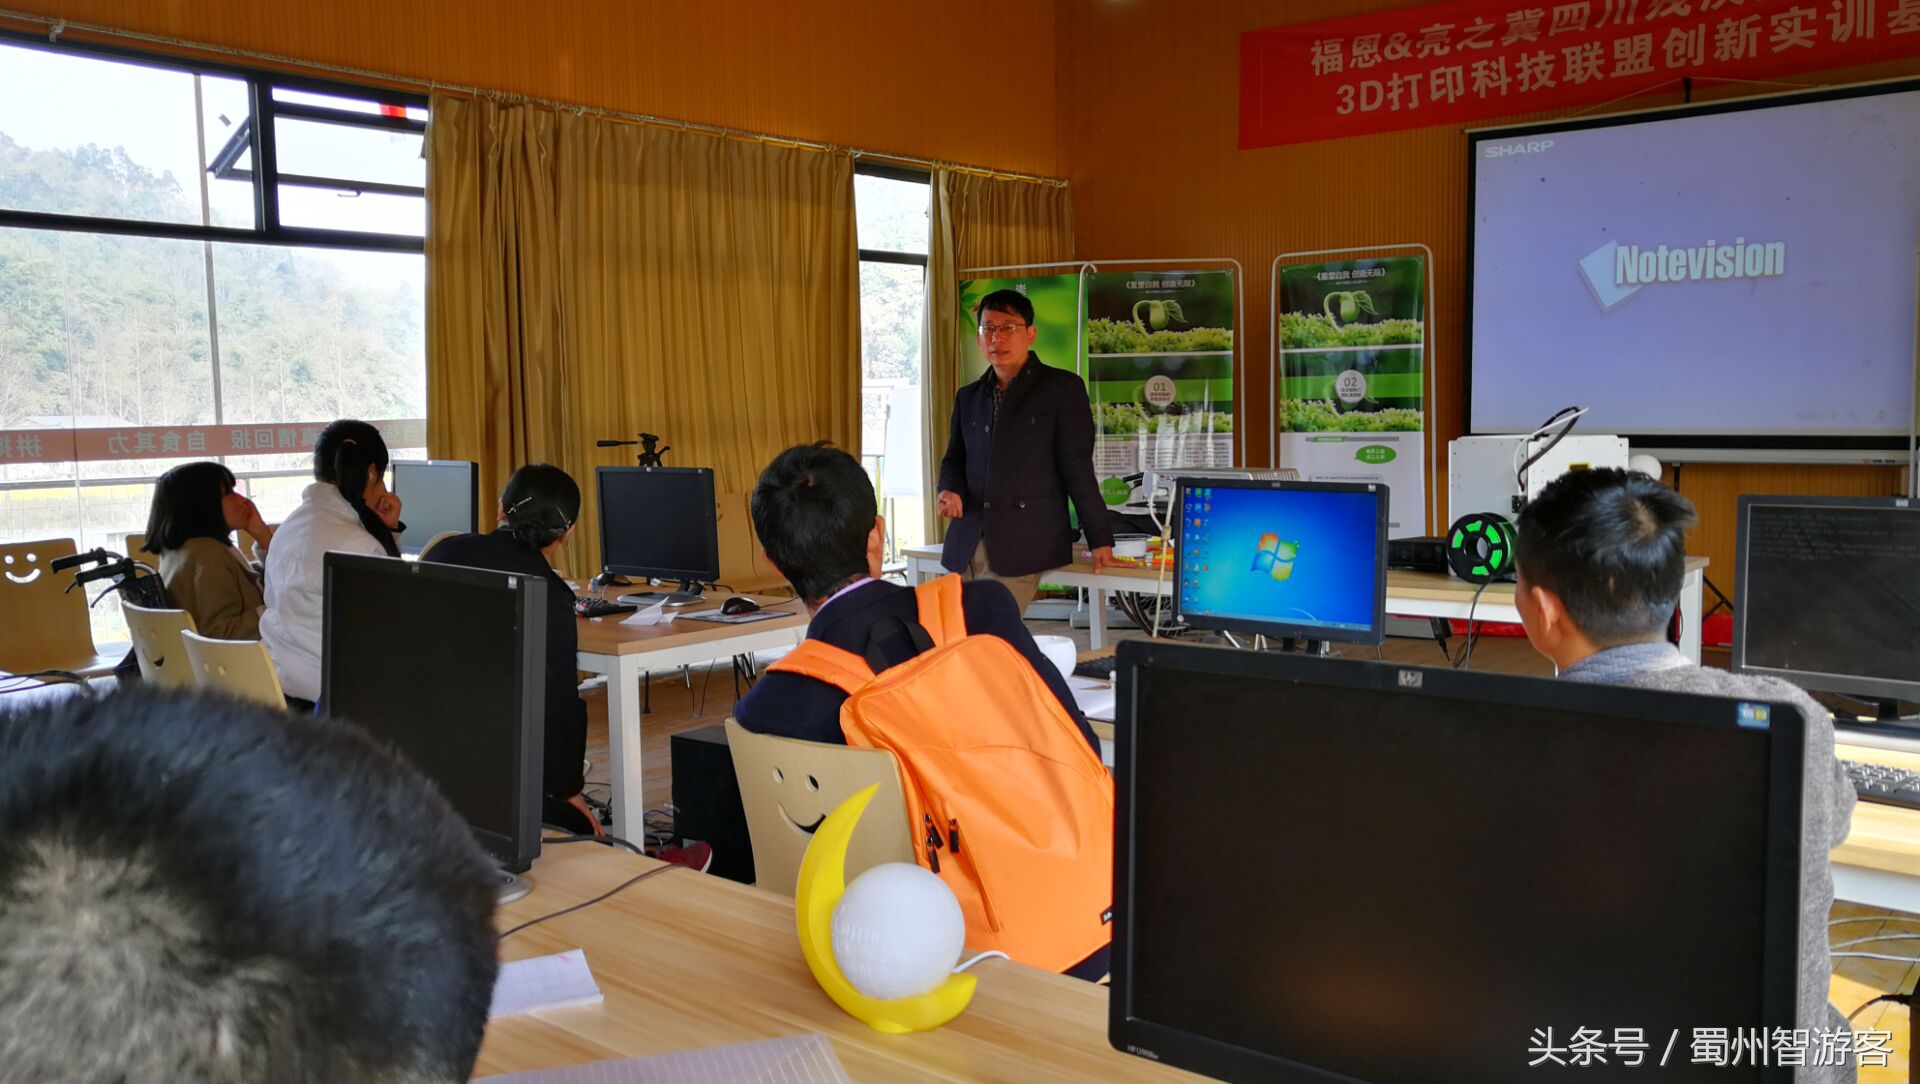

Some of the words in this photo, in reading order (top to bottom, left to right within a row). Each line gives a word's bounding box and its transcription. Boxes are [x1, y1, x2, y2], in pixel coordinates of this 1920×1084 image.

[1484, 139, 1555, 159] SHARP
[1615, 236, 1786, 285] Notevision
[1153, 382, 1167, 392] 01
[1343, 376, 1358, 387] 02
